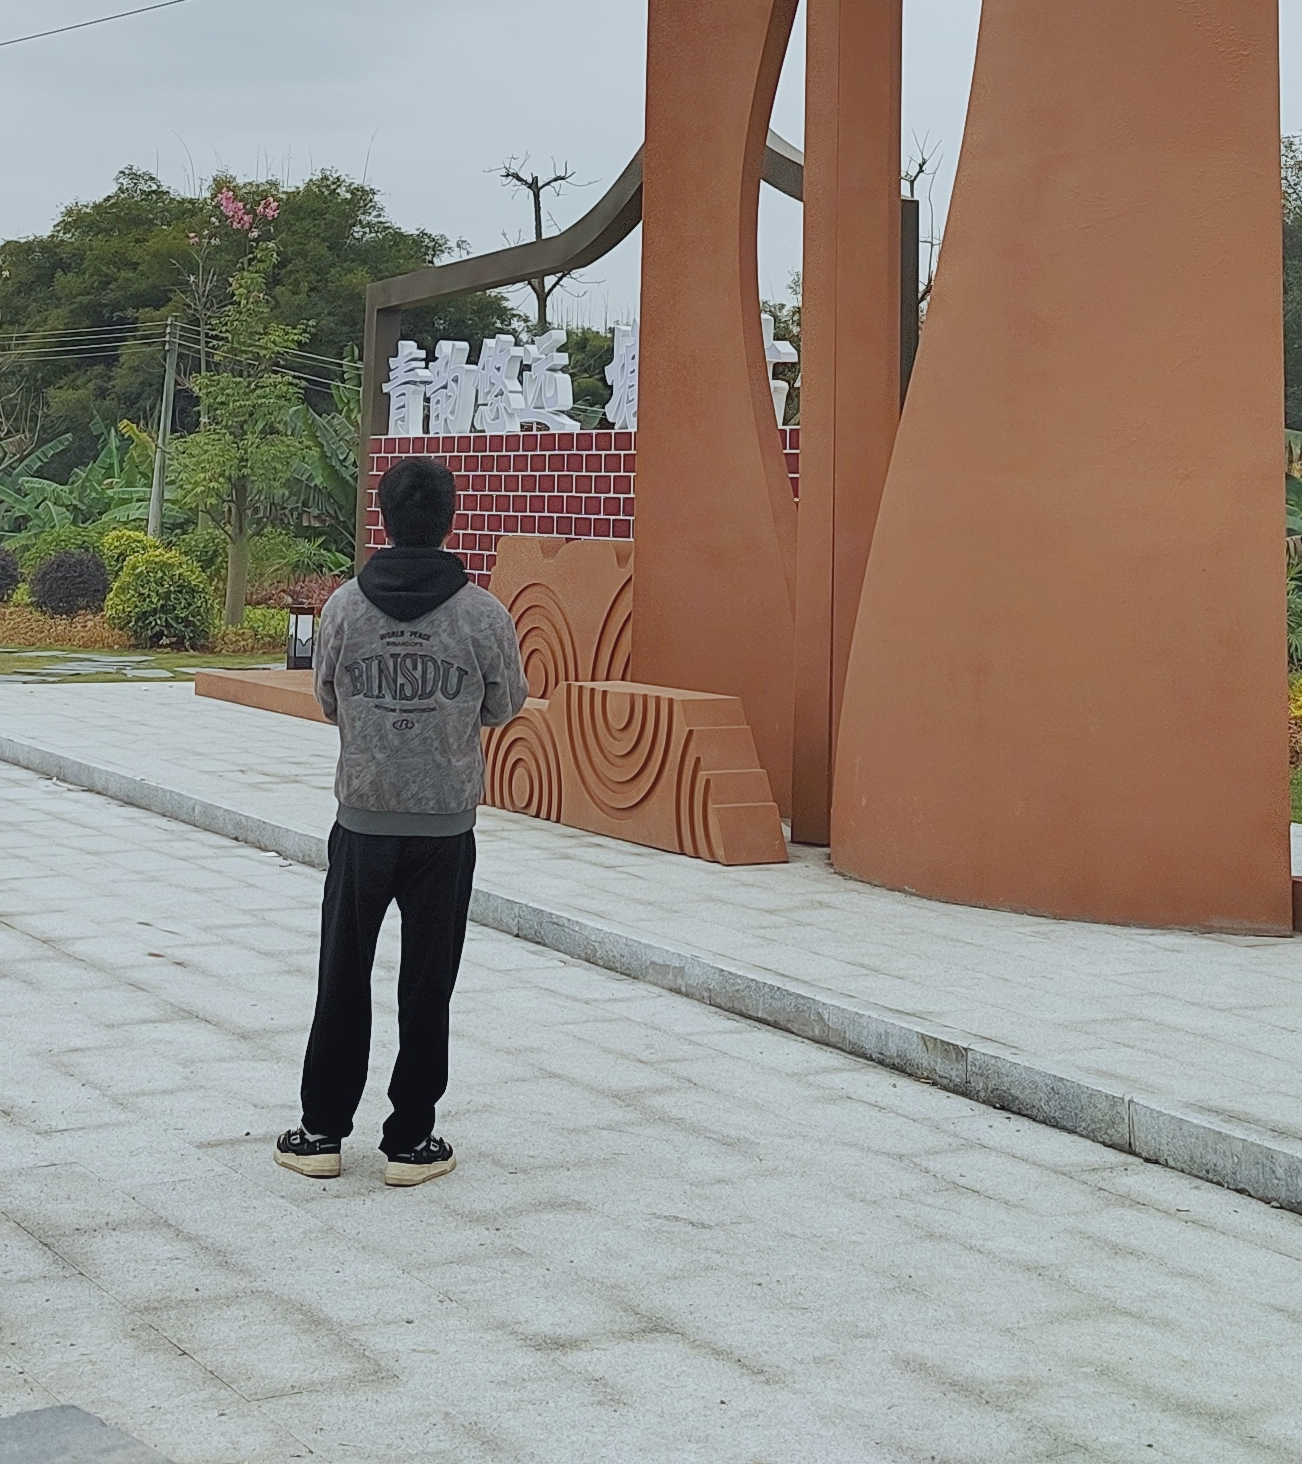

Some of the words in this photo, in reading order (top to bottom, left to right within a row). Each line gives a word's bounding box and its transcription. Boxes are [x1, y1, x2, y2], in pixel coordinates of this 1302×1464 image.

[383, 329, 581, 436] 青韵悠远
[410, 631, 432, 641] PEACE
[345, 653, 469, 701] BINSDU
